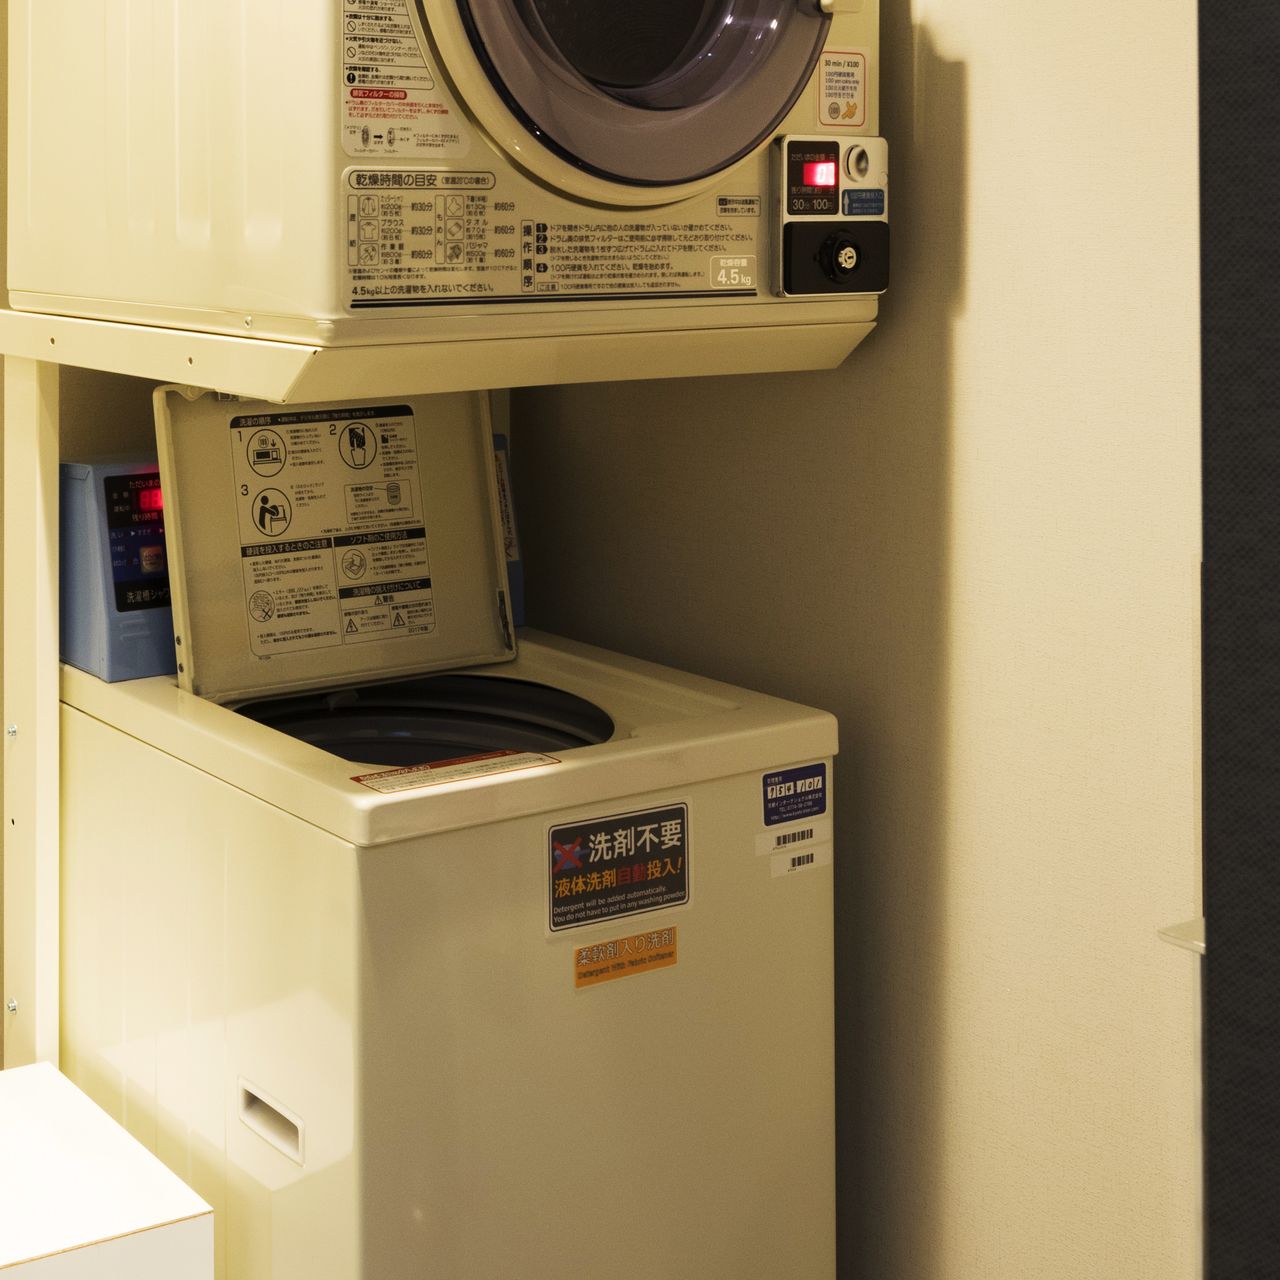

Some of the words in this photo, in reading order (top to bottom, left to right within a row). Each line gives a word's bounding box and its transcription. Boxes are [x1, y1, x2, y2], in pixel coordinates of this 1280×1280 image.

[832, 60, 841, 68] min
[718, 270, 739, 284] 4.5
[741, 276, 751, 285] kg
[589, 819, 682, 863] 洗剤不要
[555, 857, 682, 898] 液体洗剤自動投入!
[554, 902, 584, 914] Detergent
[586, 899, 596, 907] will
[598, 897, 605, 905] be
[607, 894, 626, 903] added
[554, 915, 565, 924] You
[575, 911, 585, 919] not
[586, 908, 601, 918] have
[602, 906, 609, 914] to
[609, 904, 619, 914] put
[620, 902, 626, 910] in
[627, 900, 638, 910] any
[639, 895, 662, 907] washing
[578, 931, 674, 966] 柔軟剤入り洗剤
